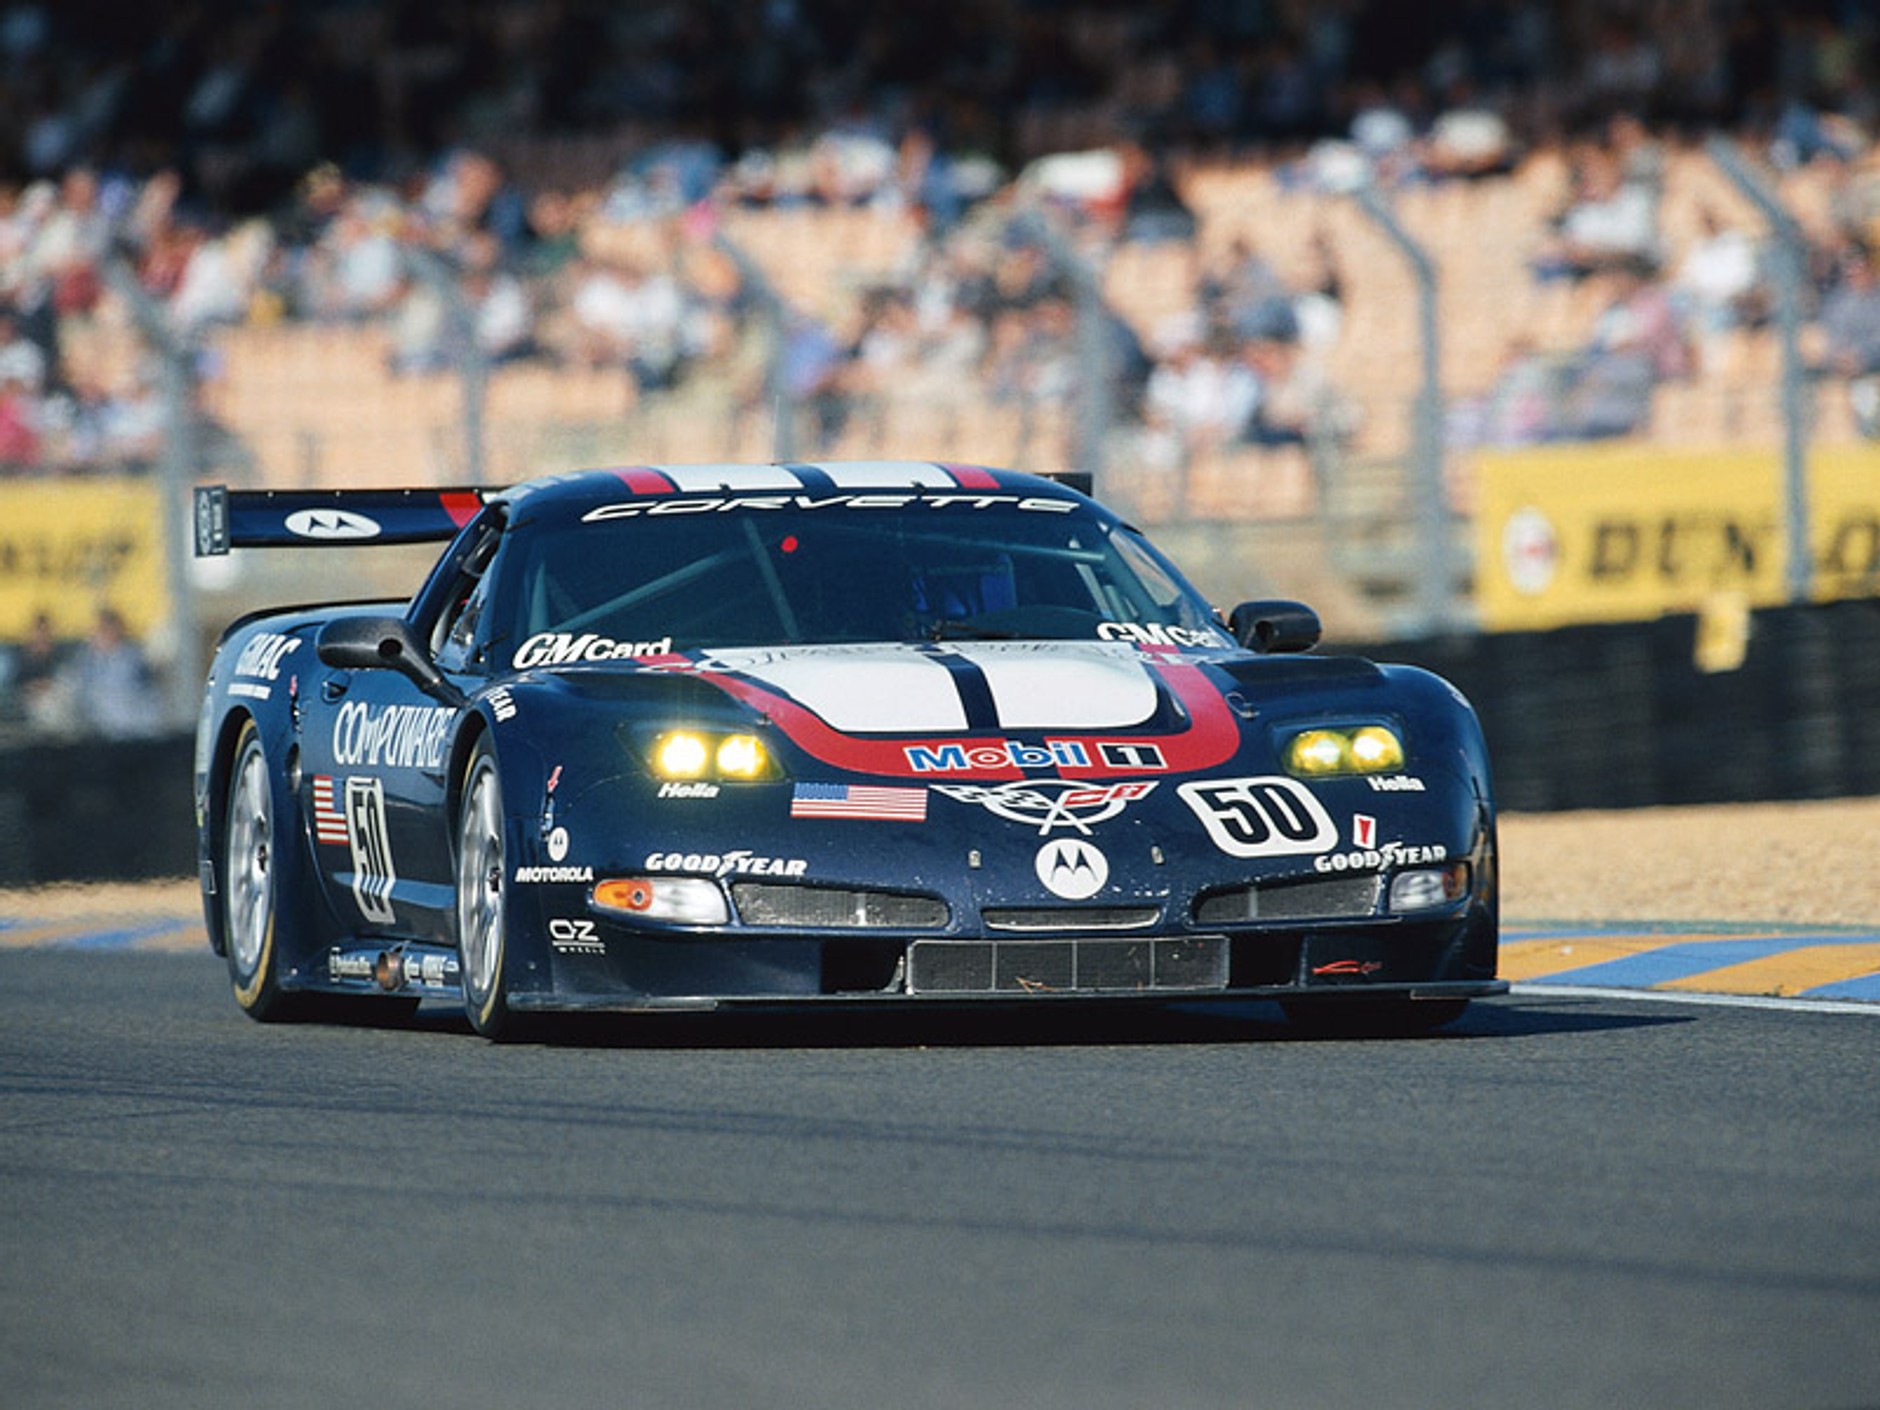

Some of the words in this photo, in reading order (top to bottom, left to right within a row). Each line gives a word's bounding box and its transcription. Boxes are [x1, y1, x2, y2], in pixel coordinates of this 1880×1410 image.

[581, 495, 1080, 522] CORVETTE
[903, 741, 1092, 772] Mobil
[658, 783, 721, 799] Hella
[1366, 776, 1426, 792] Hella
[1195, 783, 1320, 845] 50
[352, 789, 389, 914] 50
[515, 866, 594, 882] MOTOROLA
[549, 918, 600, 941] OZ
